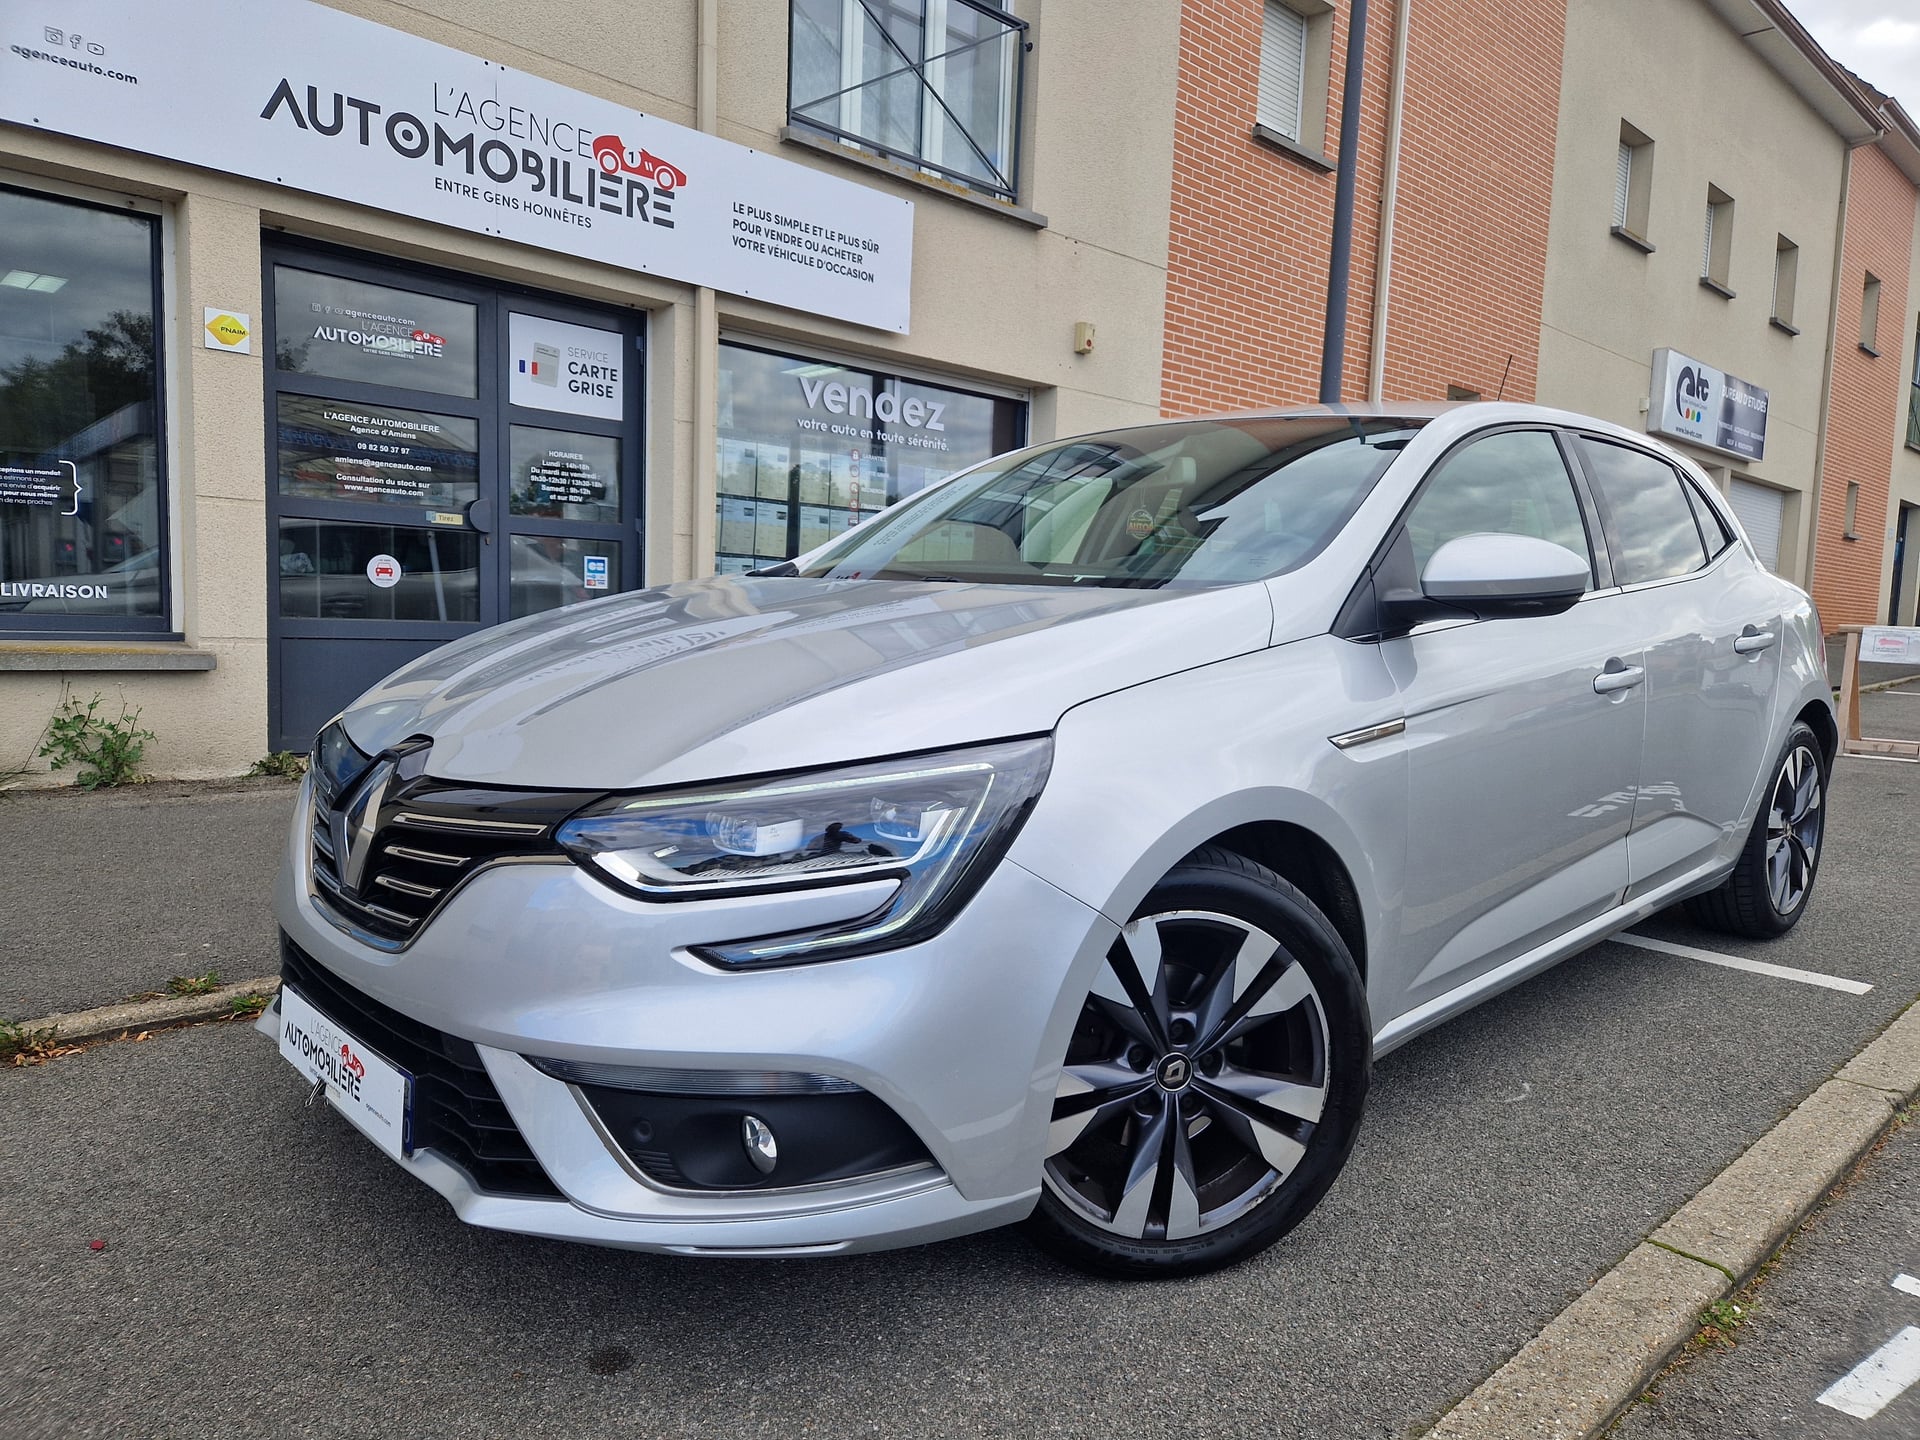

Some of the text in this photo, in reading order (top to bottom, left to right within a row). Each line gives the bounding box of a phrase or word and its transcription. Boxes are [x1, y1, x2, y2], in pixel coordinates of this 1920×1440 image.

[10, 44, 138, 85] agenceauto.com
[434, 82, 592, 159] L'AGENCE
[435, 178, 592, 228] ENTRE GENS HONNÊTES
[733, 202, 879, 254] LE PLUS SIMPLE ET LE PLUS SÛR
[733, 219, 863, 264] POUR VENDRE OU ACHETER
[733, 235, 874, 283] VOTRE VÉHICULE D'OCCASION
[345, 308, 416, 326] agenceauto.com
[220, 325, 246, 336] FNAIM
[361, 320, 413, 338] L'AGENCE
[567, 346, 608, 363] SERVICE
[568, 361, 618, 382] CARTE
[568, 379, 614, 399] GRISE
[799, 376, 945, 431] vendez
[323, 412, 440, 433] L'AGENCE AUTOMOBILIERE
[350, 425, 417, 440] Agence d'Amiens
[797, 417, 950, 452] votre auto en toute sérénité.
[368, 443, 378, 451] 82
[401, 447, 410, 455] 97
[548, 450, 583, 460] HORAIRES
[335, 456, 432, 473] amiens@agenceauto.com
[336, 473, 384, 485] Consultation
[386, 478, 396, 486] du
[397, 479, 416, 488] stock
[344, 483, 424, 497] www.agenceauto.com
[541, 484, 565, 492] Samedi
[0, 582, 109, 599] LIVRAISON
[310, 1018, 342, 1056] L'AGENCE
